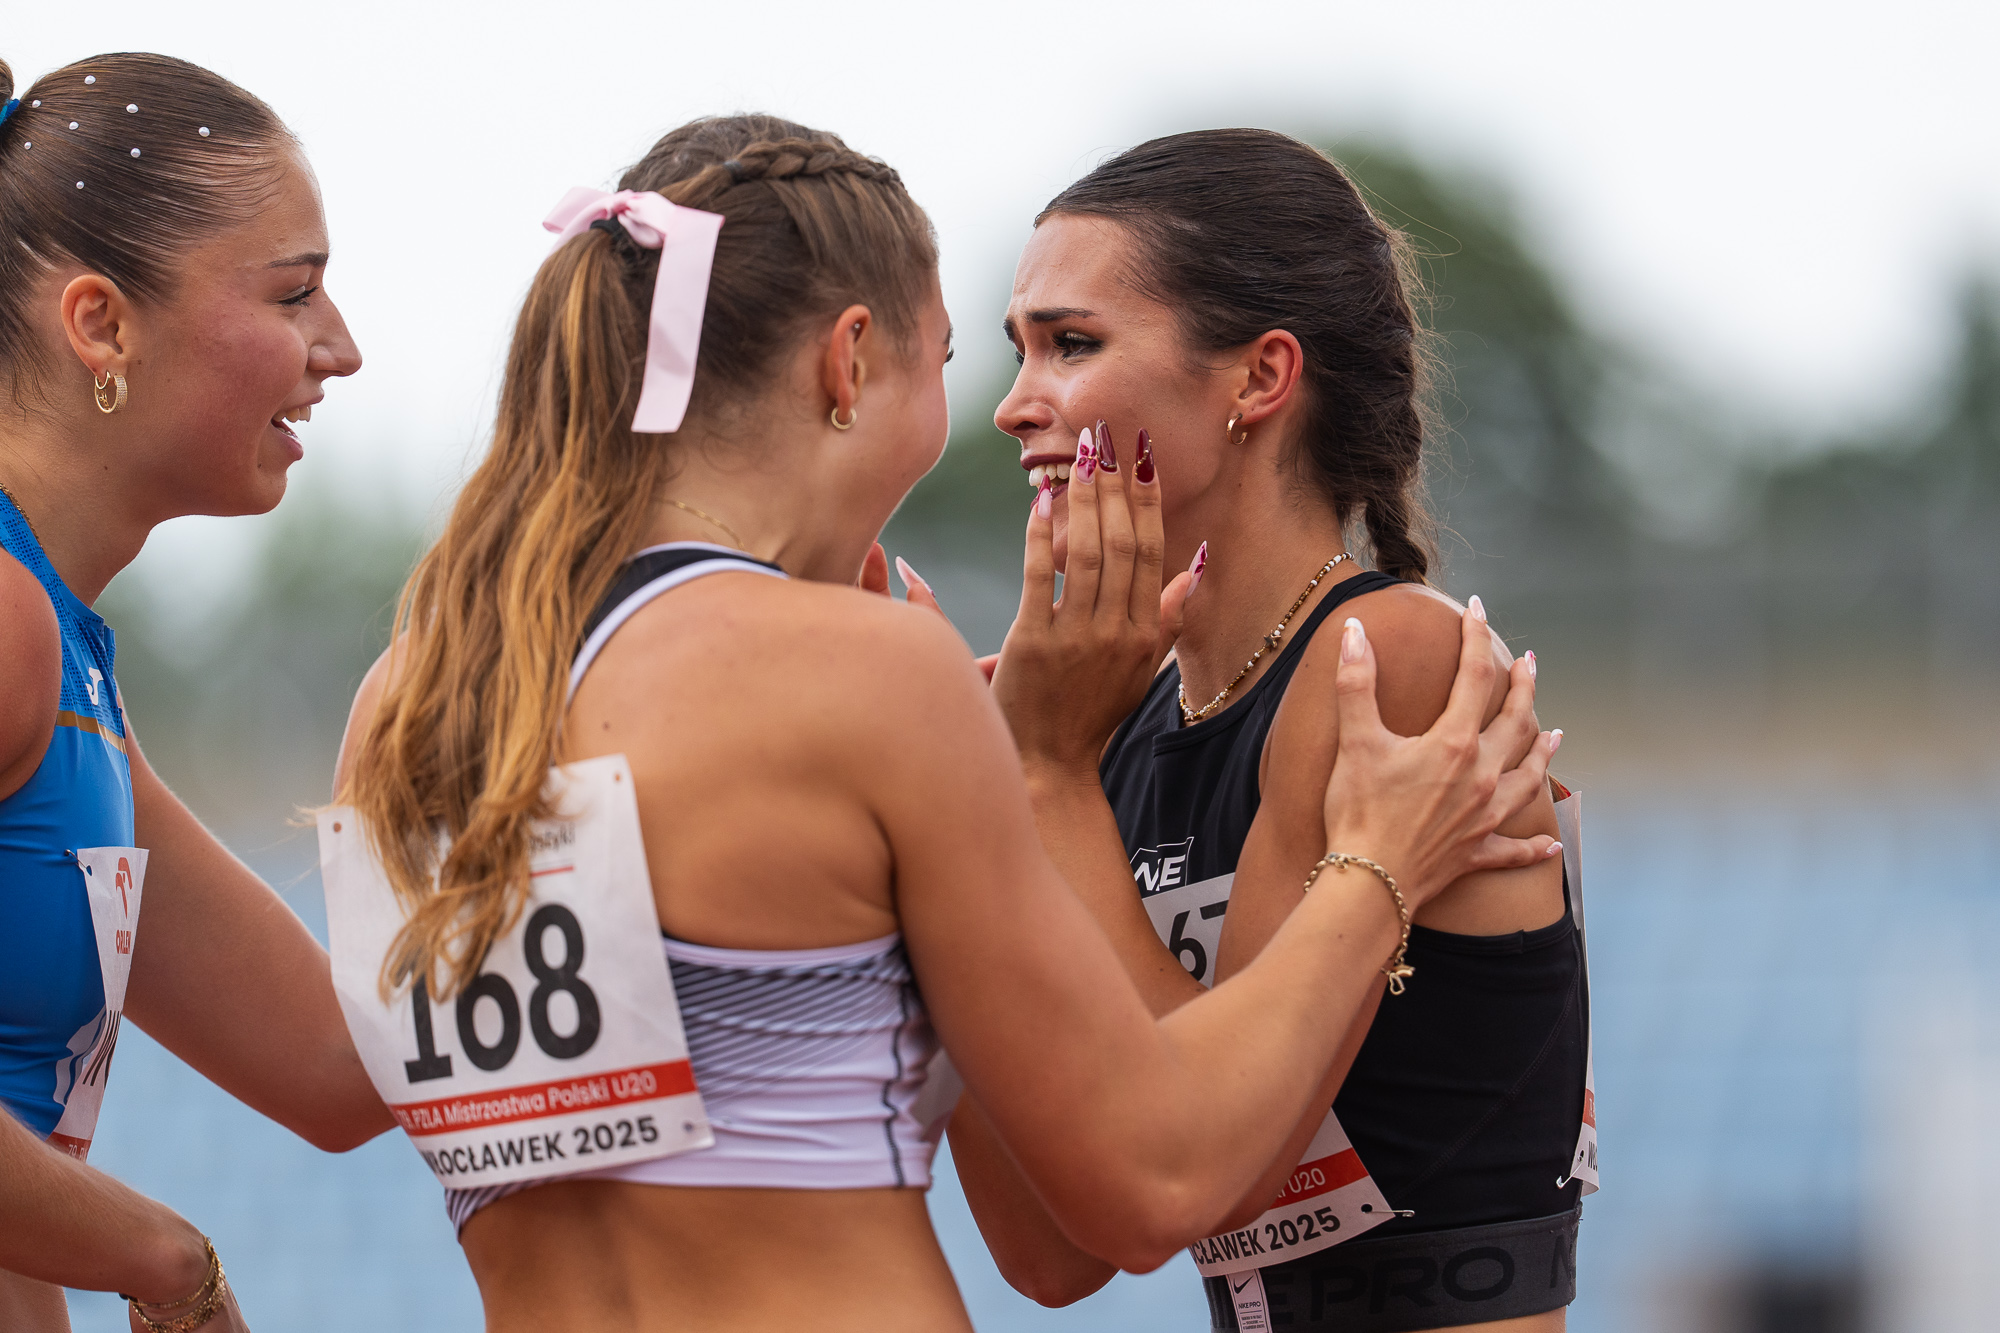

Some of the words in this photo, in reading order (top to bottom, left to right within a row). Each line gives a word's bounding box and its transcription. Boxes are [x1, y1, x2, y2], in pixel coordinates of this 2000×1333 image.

[391, 904, 602, 1084] 168
[411, 1106, 445, 1130] PZLA
[443, 1092, 547, 1125] Mistrzostwa
[548, 1076, 611, 1110] Polski
[611, 1069, 657, 1099] U20
[574, 1116, 659, 1155] 2025
[1287, 1167, 1326, 1194] U20
[1192, 1227, 1267, 1265] CŁAWEK
[1265, 1206, 1341, 1251] 2025
